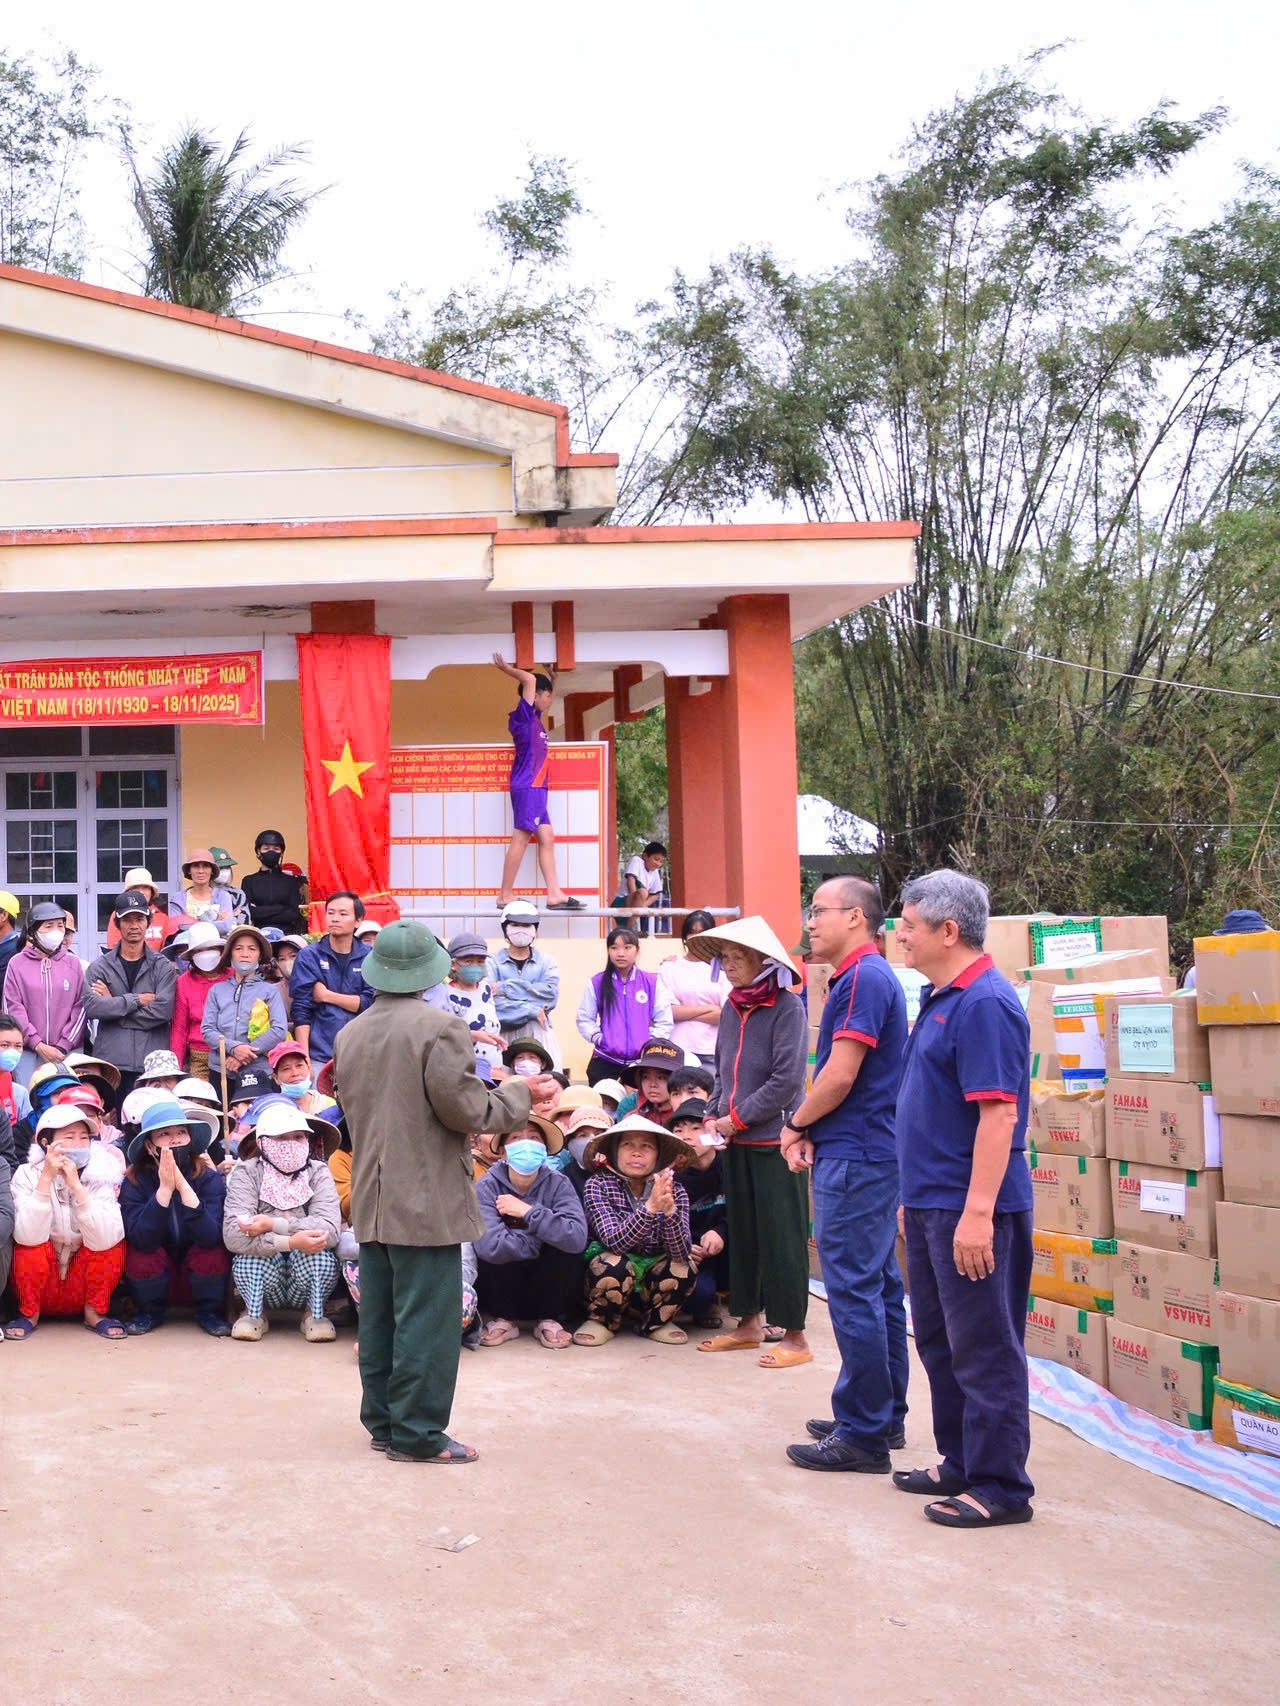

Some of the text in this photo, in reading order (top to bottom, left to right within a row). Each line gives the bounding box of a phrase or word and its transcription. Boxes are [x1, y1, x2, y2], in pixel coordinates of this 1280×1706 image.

[15, 669, 46, 692] TRẬN
[49, 668, 73, 688] DÂN
[77, 668, 101, 692] TỘC
[104, 664, 144, 687] THỐNG
[148, 663, 180, 686] NHẤT
[183, 664, 210, 688] VIỆT
[220, 667, 246, 683] NAM
[2, 695, 32, 720] VIỆT
[38, 698, 67, 715] NAM
[72, 697, 148, 718] (18/11/1930
[164, 694, 240, 713] 18/11/2025)
[1113, 1094, 1148, 1109] FAHASA
[1048, 1130, 1080, 1142] FAHASA
[1118, 1177, 1141, 1191] FAHA
[1027, 1311, 1056, 1329] AHASA
[1164, 1305, 1211, 1328] FAHASA
[1112, 1336, 1148, 1359] FAHASA
[1241, 1417, 1278, 1436] QUẦN ÁO
